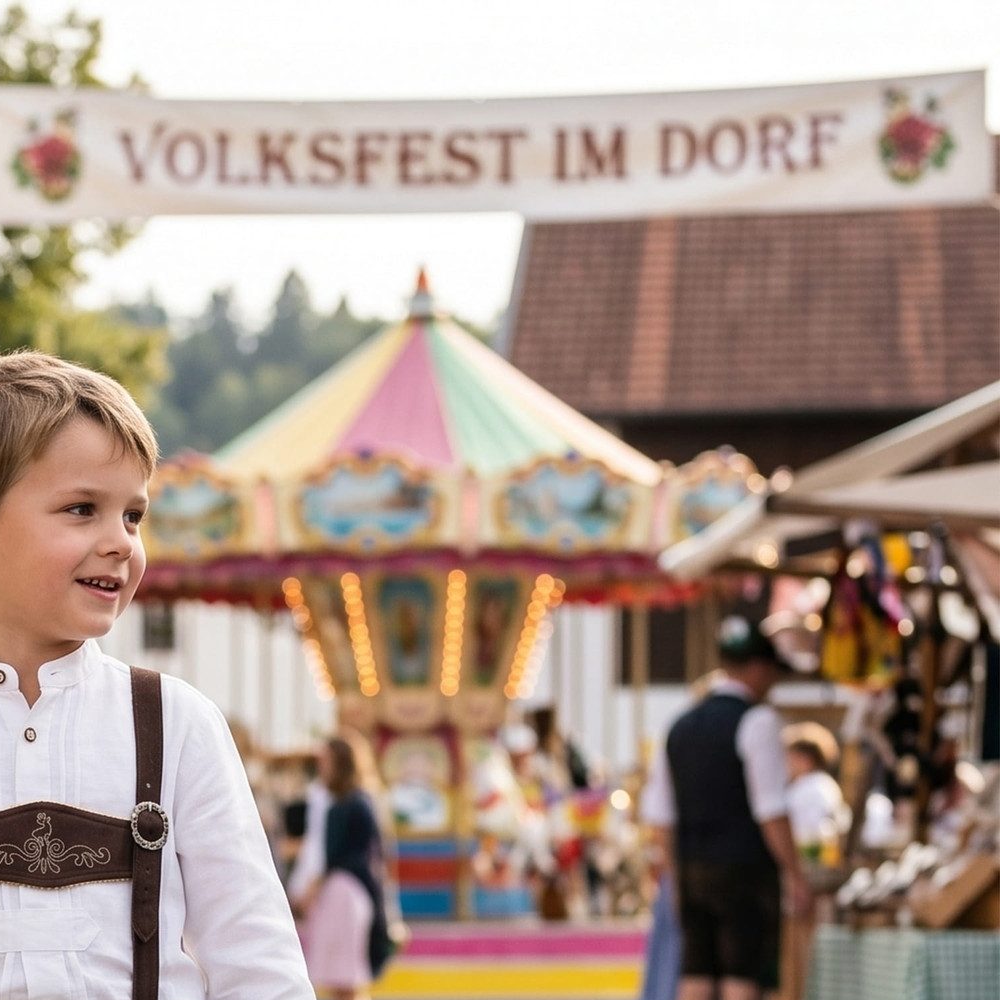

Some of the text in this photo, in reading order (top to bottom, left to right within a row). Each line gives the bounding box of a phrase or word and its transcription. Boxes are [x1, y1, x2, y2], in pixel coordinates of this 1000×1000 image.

[118, 112, 844, 185] VOLKSFEST IM DORF
